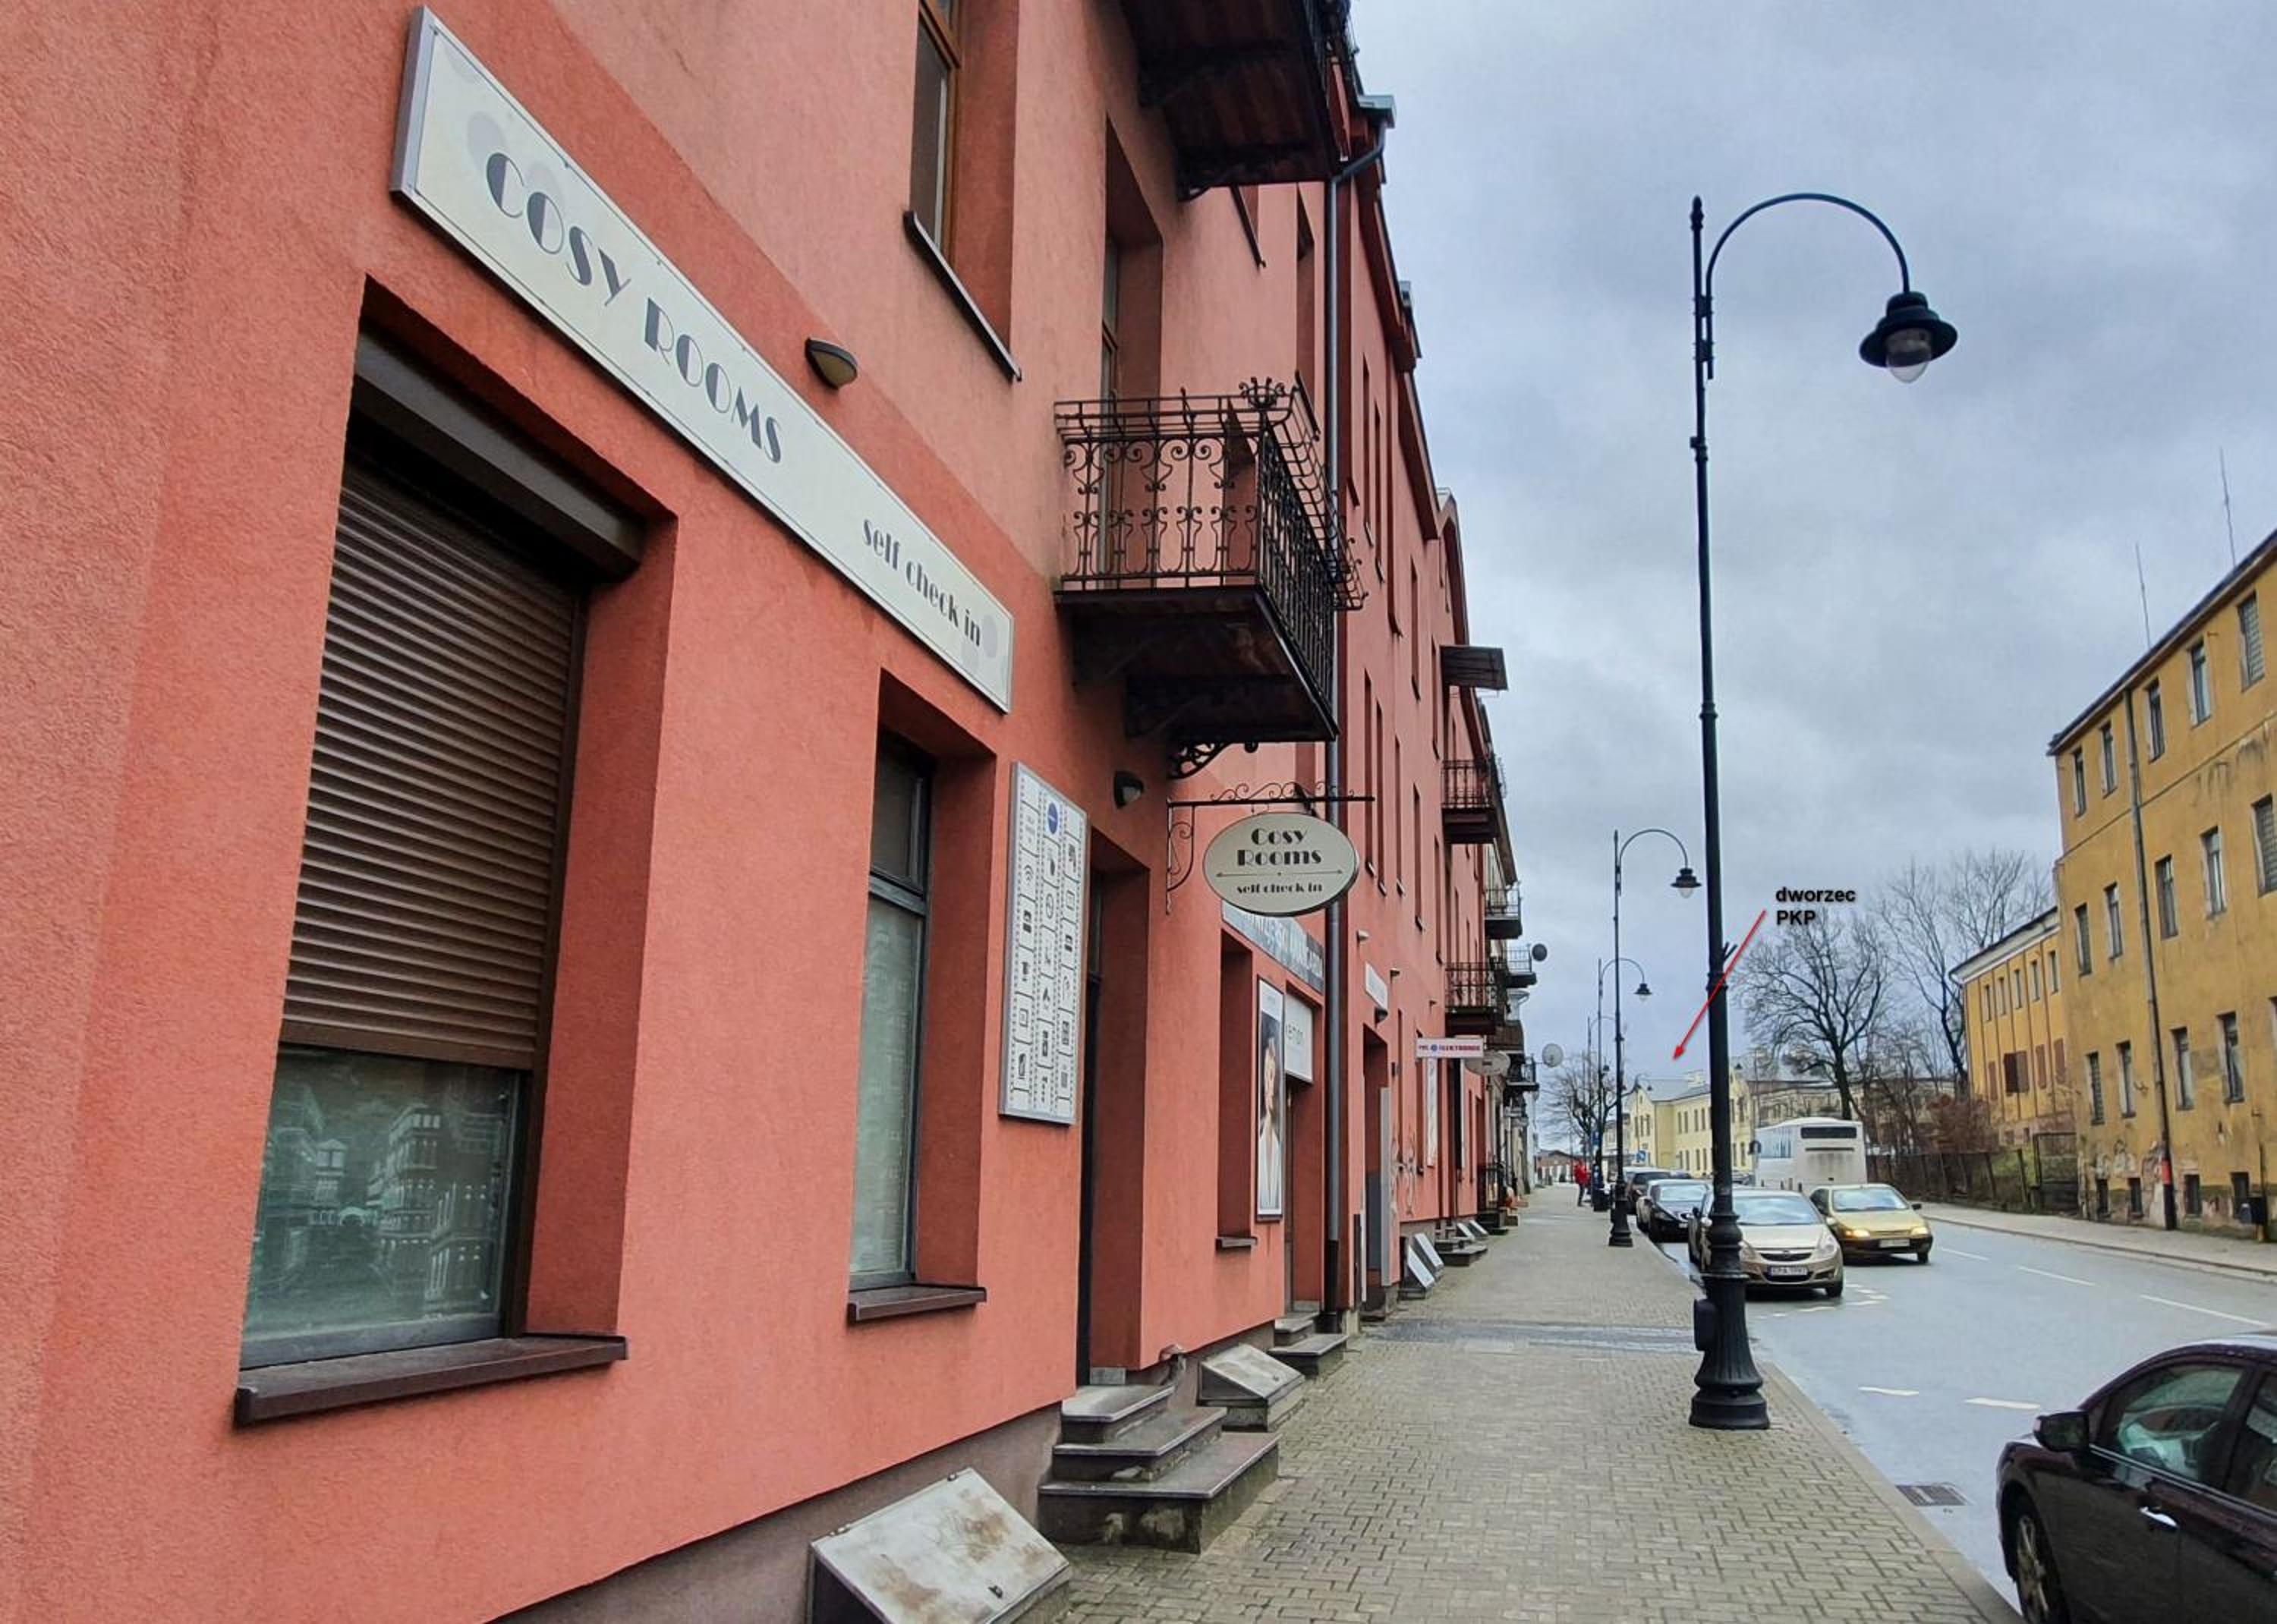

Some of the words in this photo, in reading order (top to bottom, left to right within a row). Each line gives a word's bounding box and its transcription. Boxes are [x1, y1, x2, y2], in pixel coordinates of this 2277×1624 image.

[486, 152, 631, 307] COSY
[644, 298, 782, 464] ROOMS
[863, 518, 901, 571] self
[905, 559, 959, 628] check
[964, 609, 981, 647] in
[1236, 882, 1260, 894] self
[1263, 882, 1305, 893] check
[1308, 881, 1323, 892] in
